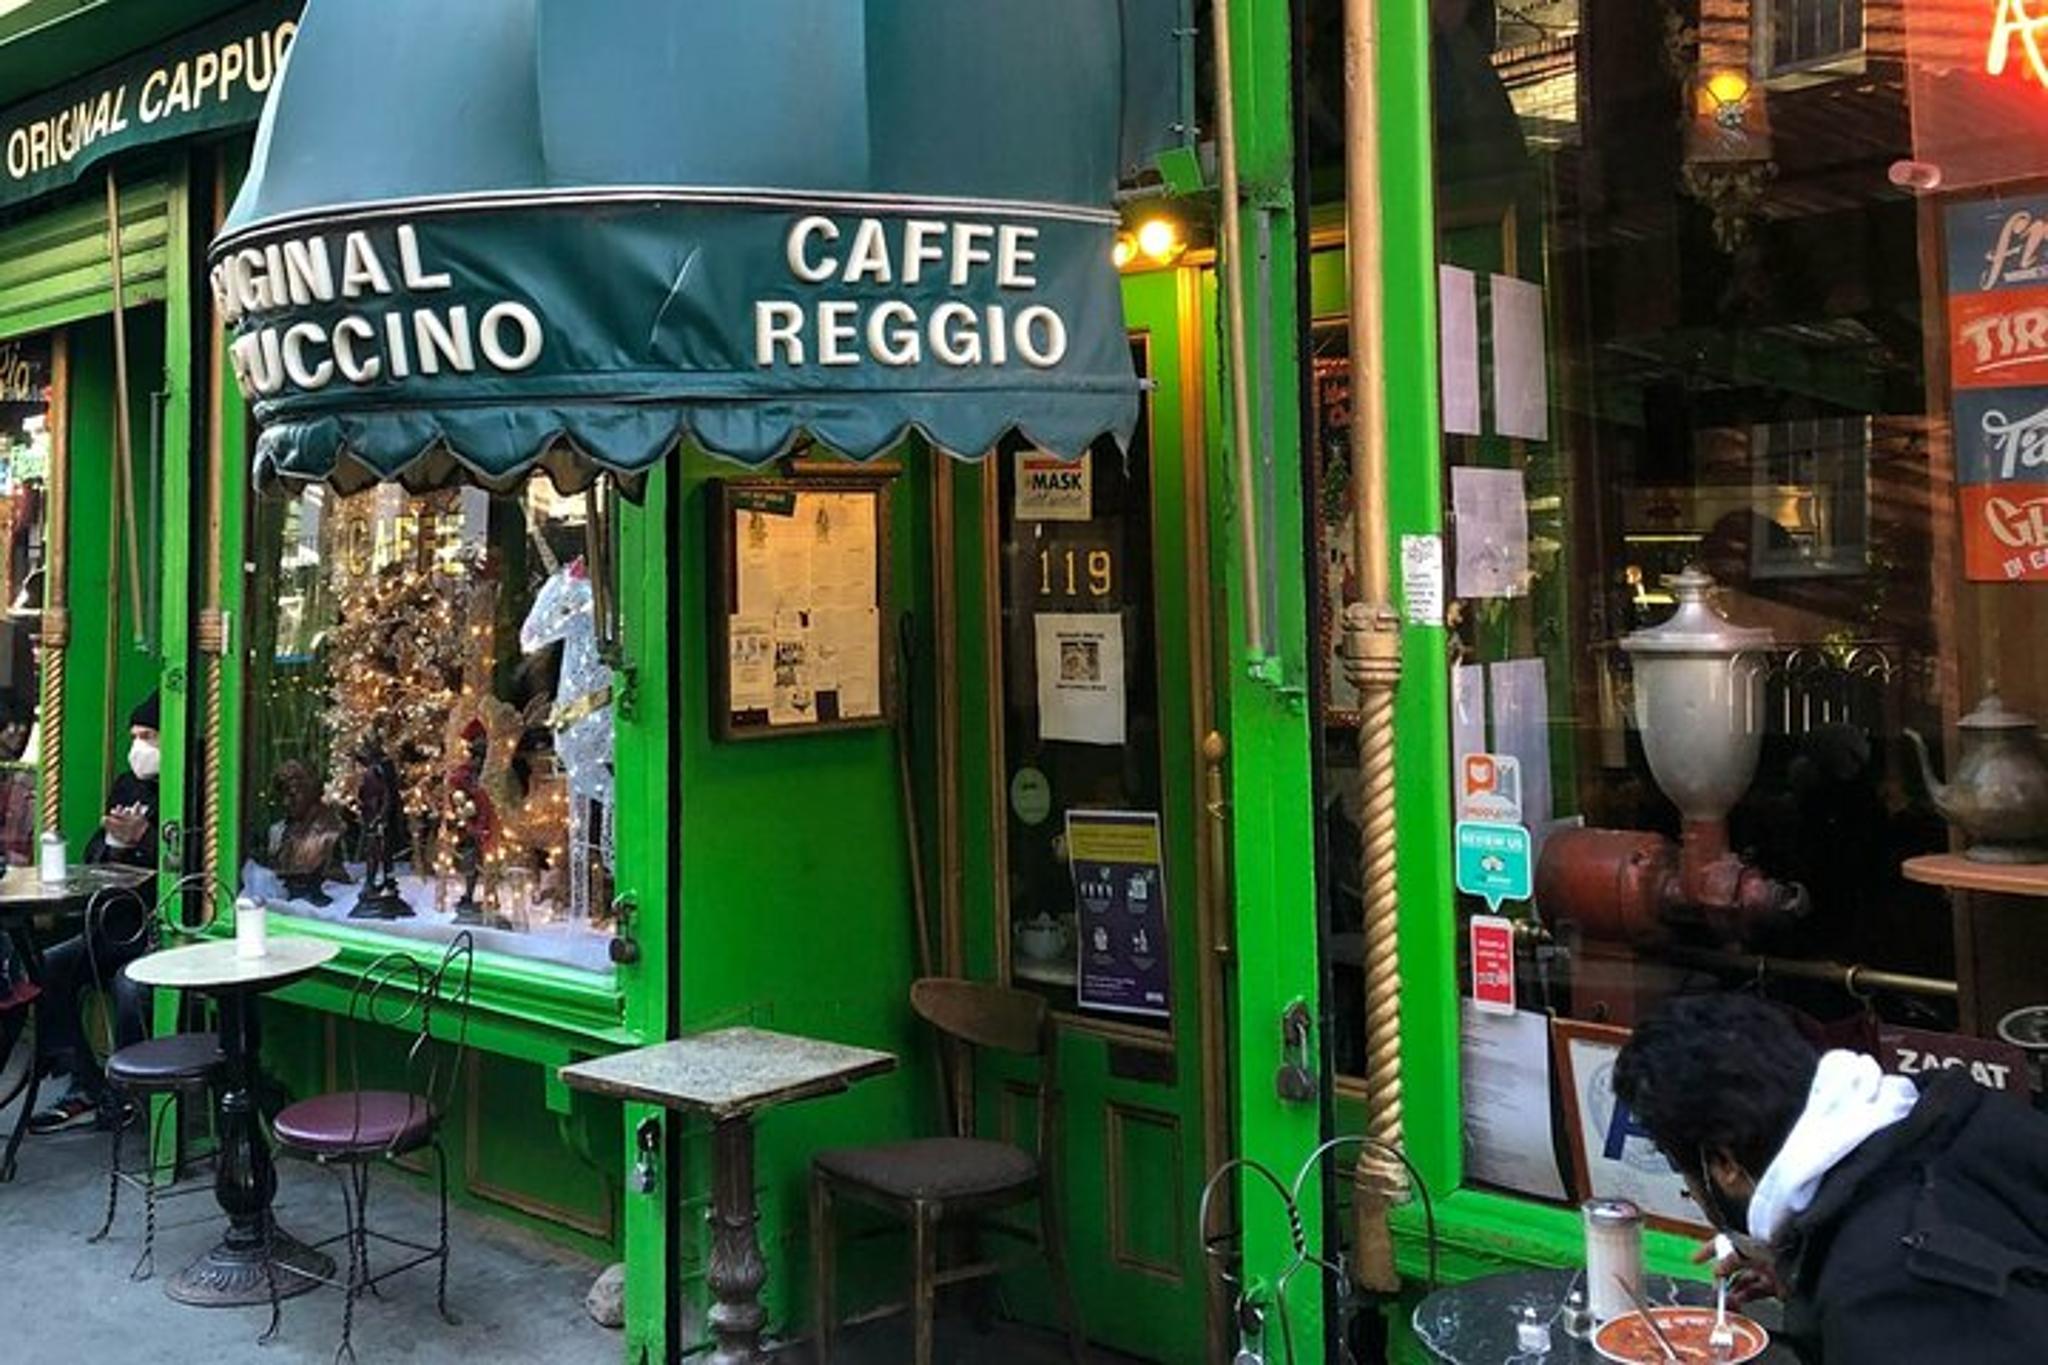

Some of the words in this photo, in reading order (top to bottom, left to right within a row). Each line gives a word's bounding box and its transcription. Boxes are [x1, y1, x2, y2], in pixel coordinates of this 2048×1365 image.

[787, 215, 1040, 288] CAFFE
[755, 300, 1067, 368] REGGIO
[1032, 472, 1082, 491] MASK
[1040, 550, 1111, 595] 119
[1896, 1048, 2010, 1091] ZAAT
